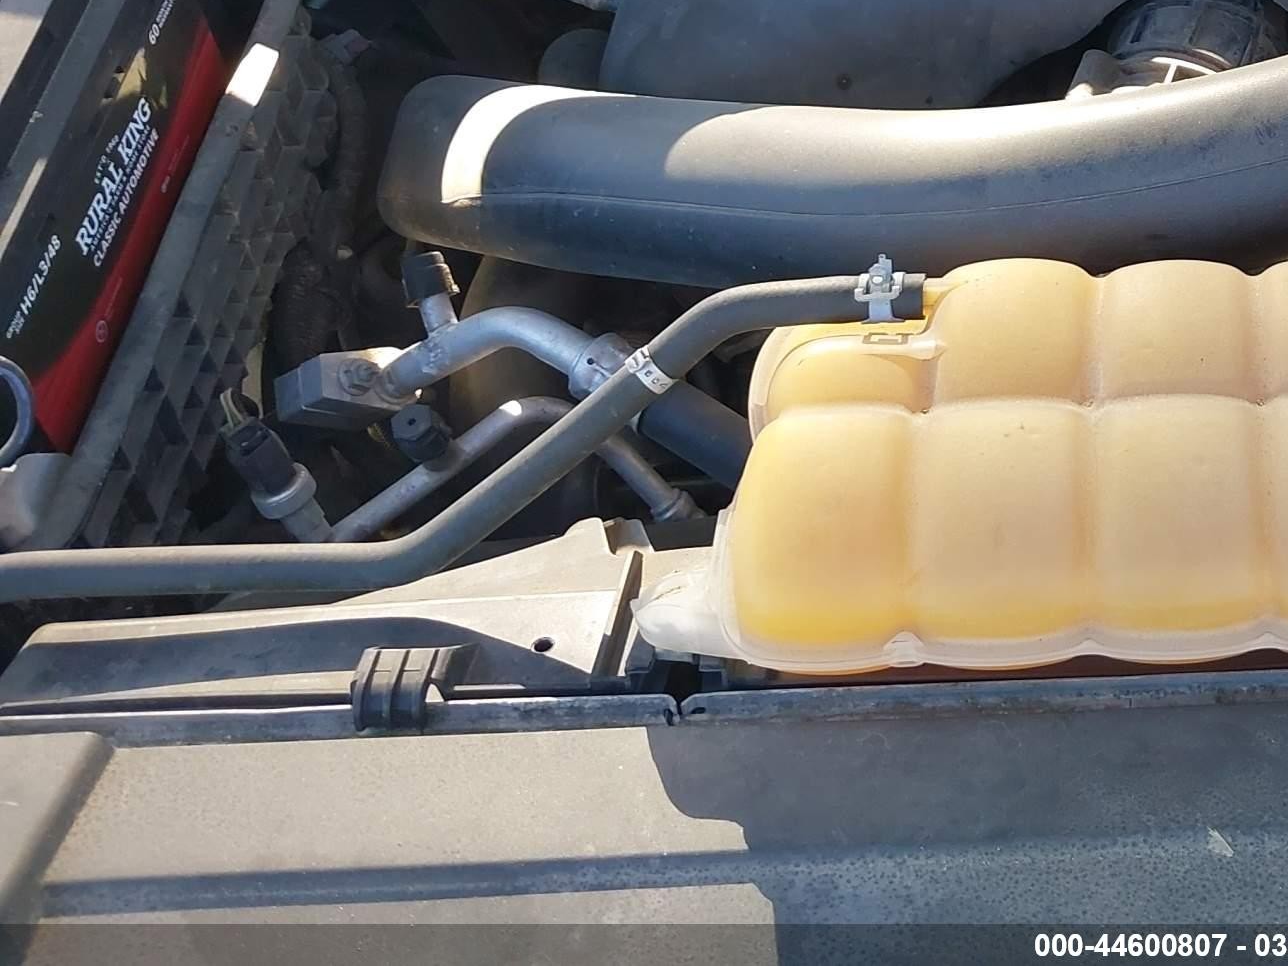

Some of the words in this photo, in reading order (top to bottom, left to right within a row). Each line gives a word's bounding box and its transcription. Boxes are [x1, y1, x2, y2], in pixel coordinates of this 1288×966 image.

[147, 23, 160, 44] 60
[75, 160, 123, 256] RURAL
[118, 97, 152, 165] KING
[93, 211, 122, 266] CLASSIC
[118, 127, 159, 213] AUTOMOTIVE
[19, 234, 61, 314] H6/L3/48
